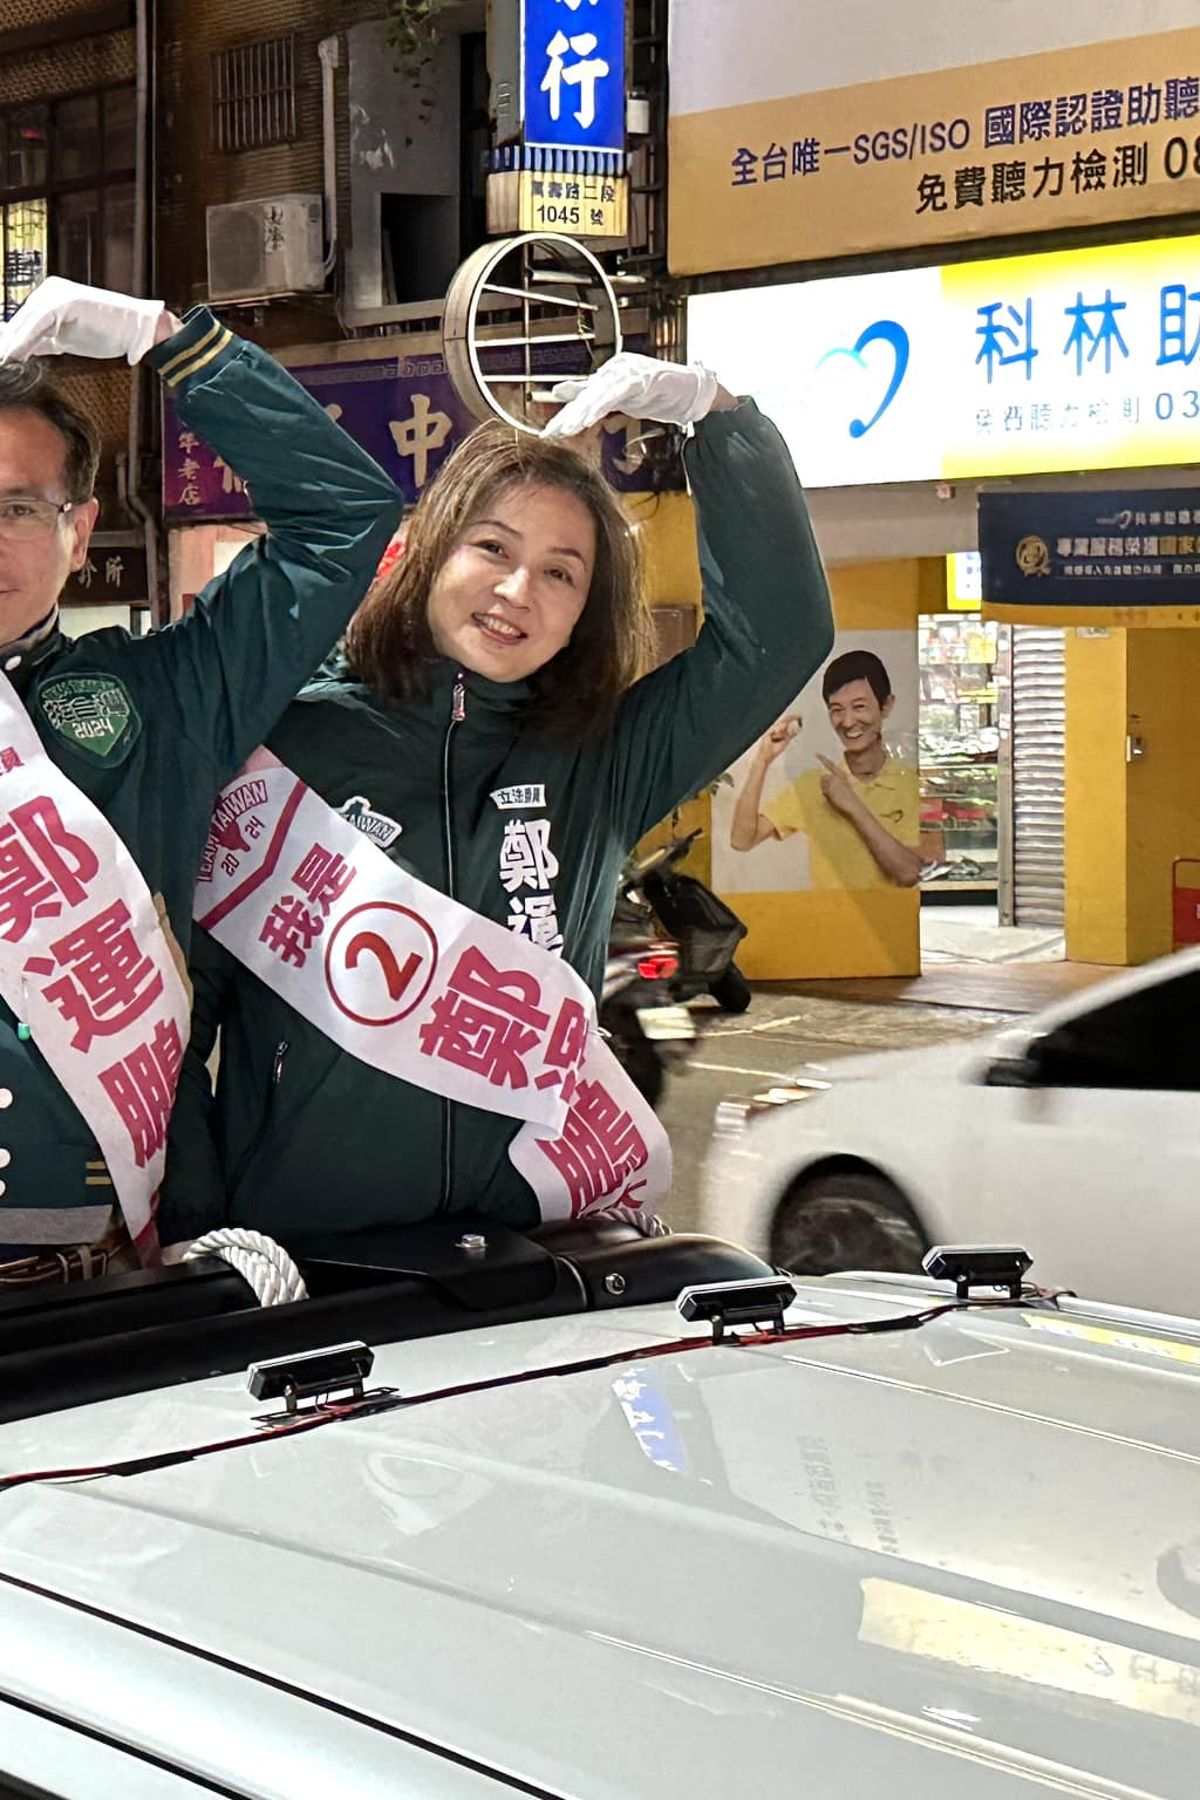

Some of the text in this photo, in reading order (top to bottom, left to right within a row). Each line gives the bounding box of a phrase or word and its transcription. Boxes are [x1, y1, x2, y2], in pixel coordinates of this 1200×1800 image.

[540, 0, 610, 130] 行
[731, 76, 1200, 187] 全台唯一SGS/ISO 國際認證助聽
[915, 135, 1200, 214] 免費聽力檢測 0
[536, 204, 580, 224] 1045
[974, 284, 1200, 385] 科林助
[258, 842, 360, 969] 我是
